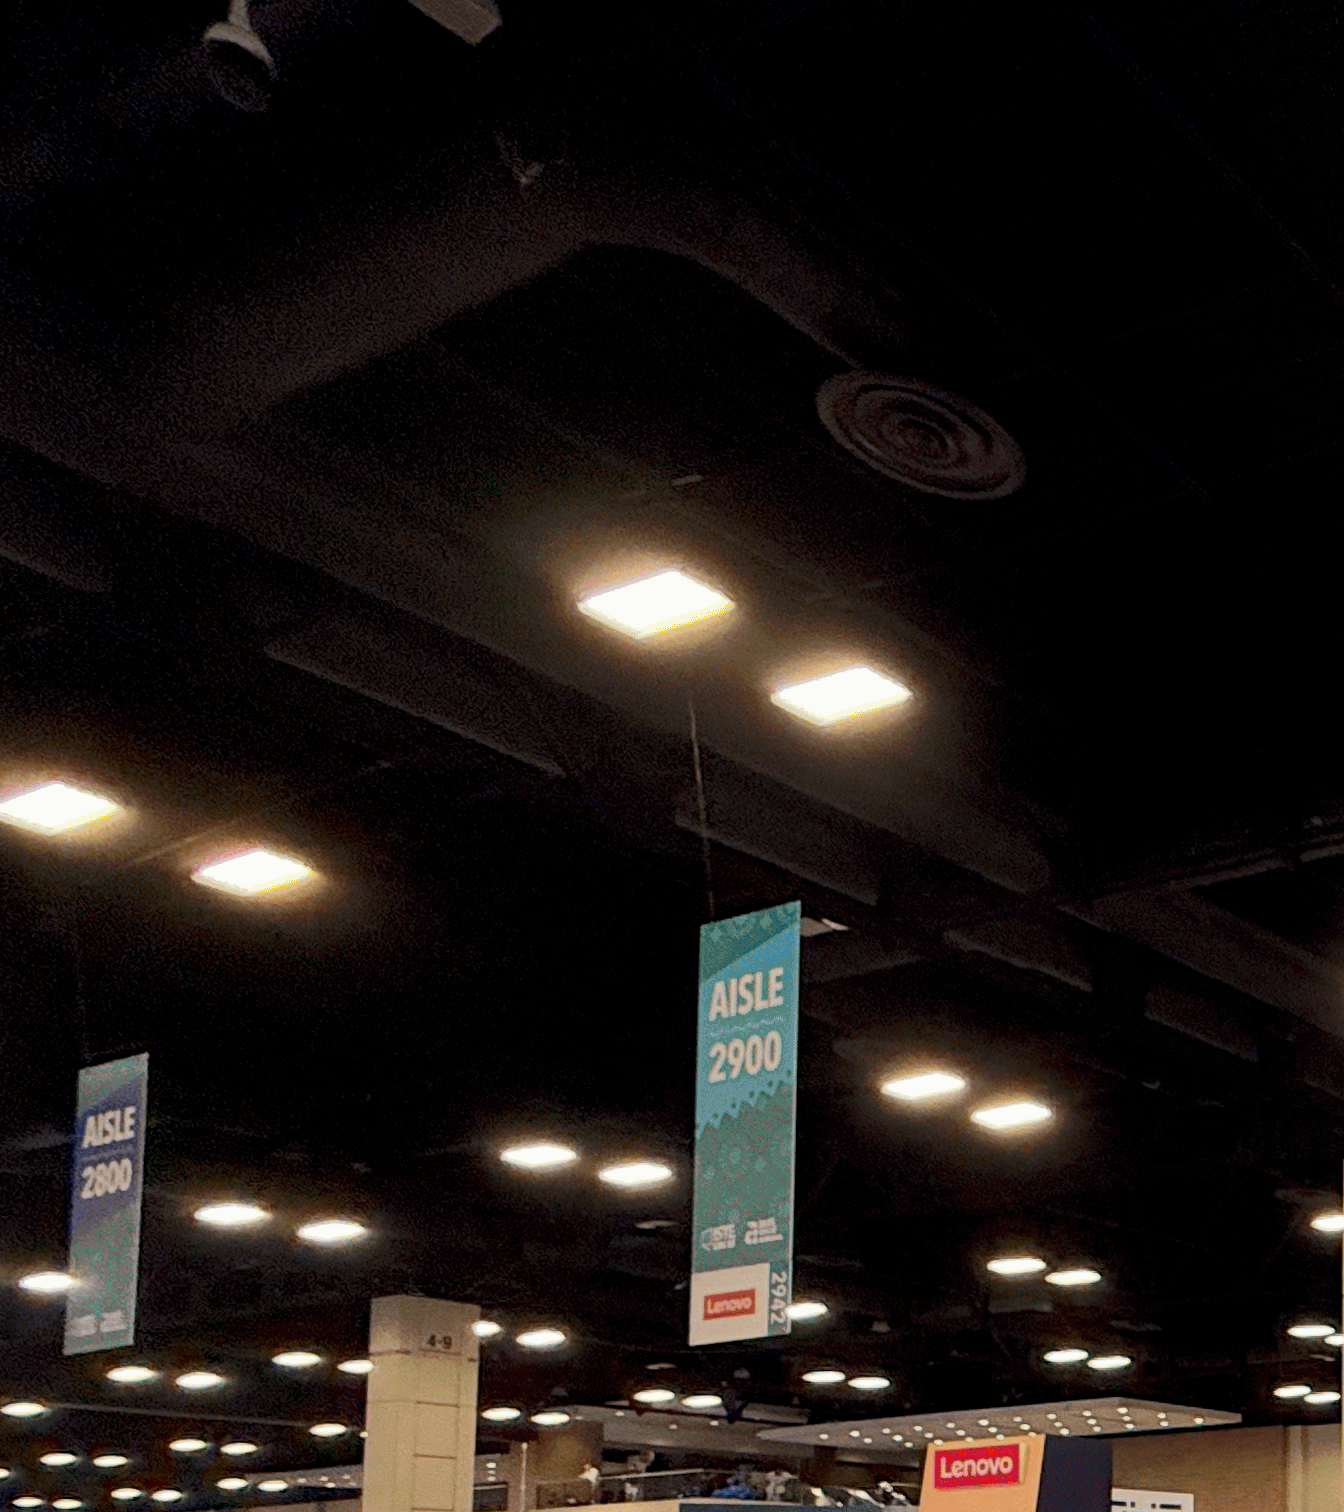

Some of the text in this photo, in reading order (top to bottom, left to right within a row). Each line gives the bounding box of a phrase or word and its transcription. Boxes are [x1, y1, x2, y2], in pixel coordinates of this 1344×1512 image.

[709, 967, 784, 1022] AISLE
[709, 1031, 782, 1082] 2900
[82, 1106, 136, 1148] AISLE
[81, 1158, 132, 1199] 2800
[771, 1271, 788, 1324] 2942
[939, 1456, 1014, 1479] Lenovo
